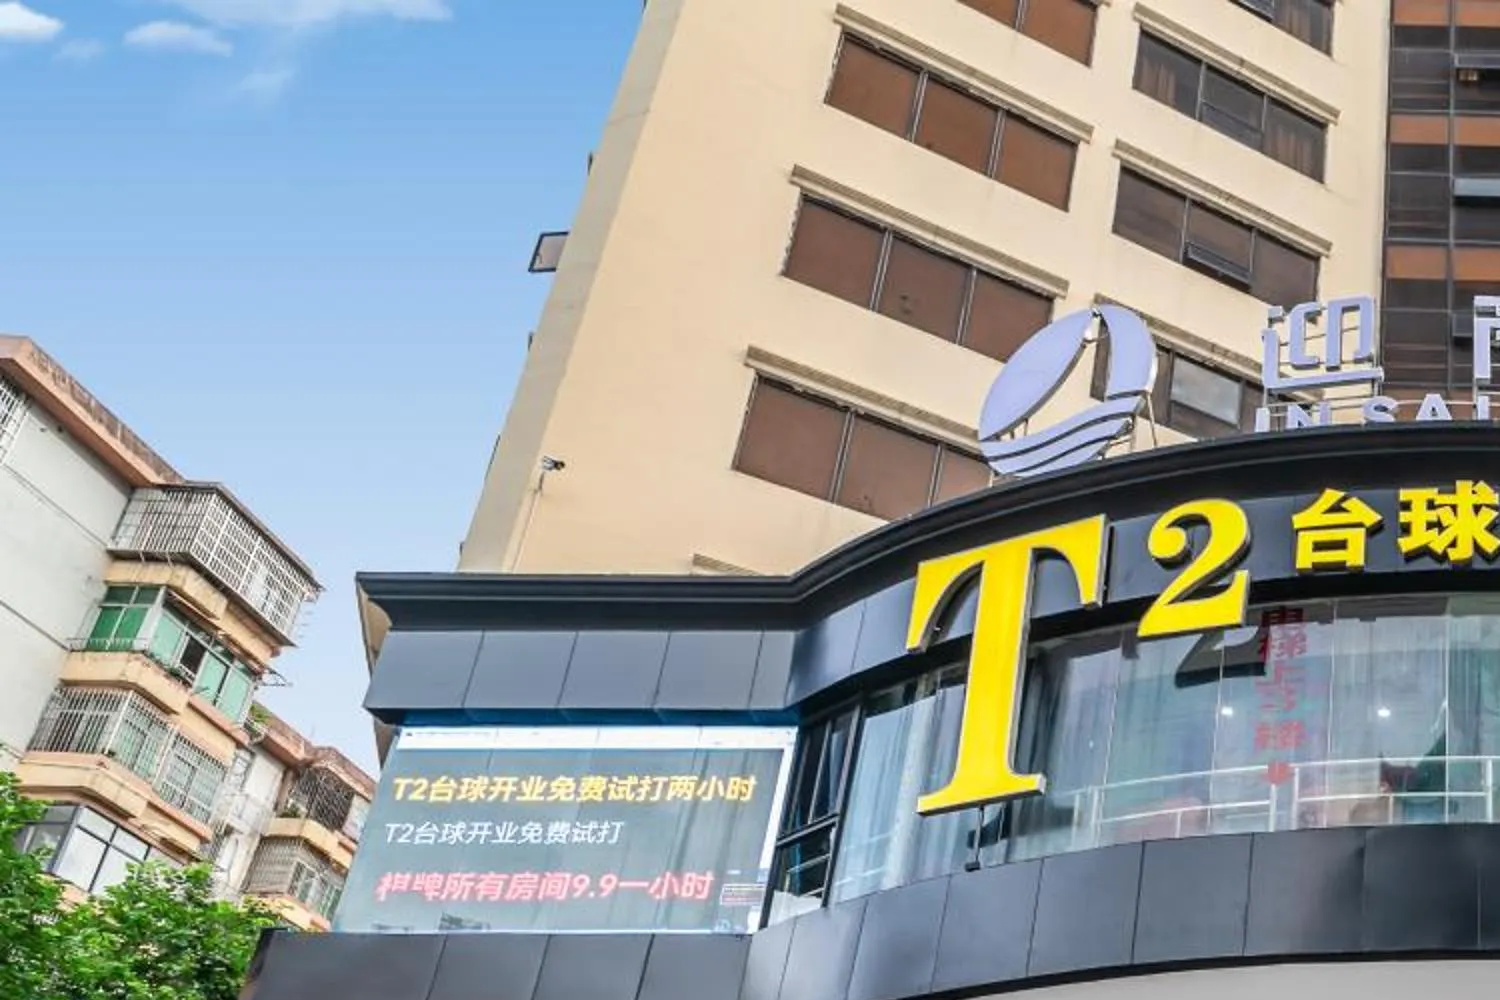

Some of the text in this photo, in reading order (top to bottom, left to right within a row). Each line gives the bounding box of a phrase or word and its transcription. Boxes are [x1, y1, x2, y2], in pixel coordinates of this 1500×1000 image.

[391, 773, 758, 804] T2台球开业免费试打两小时
[384, 820, 625, 847] T2台球开业免费试打
